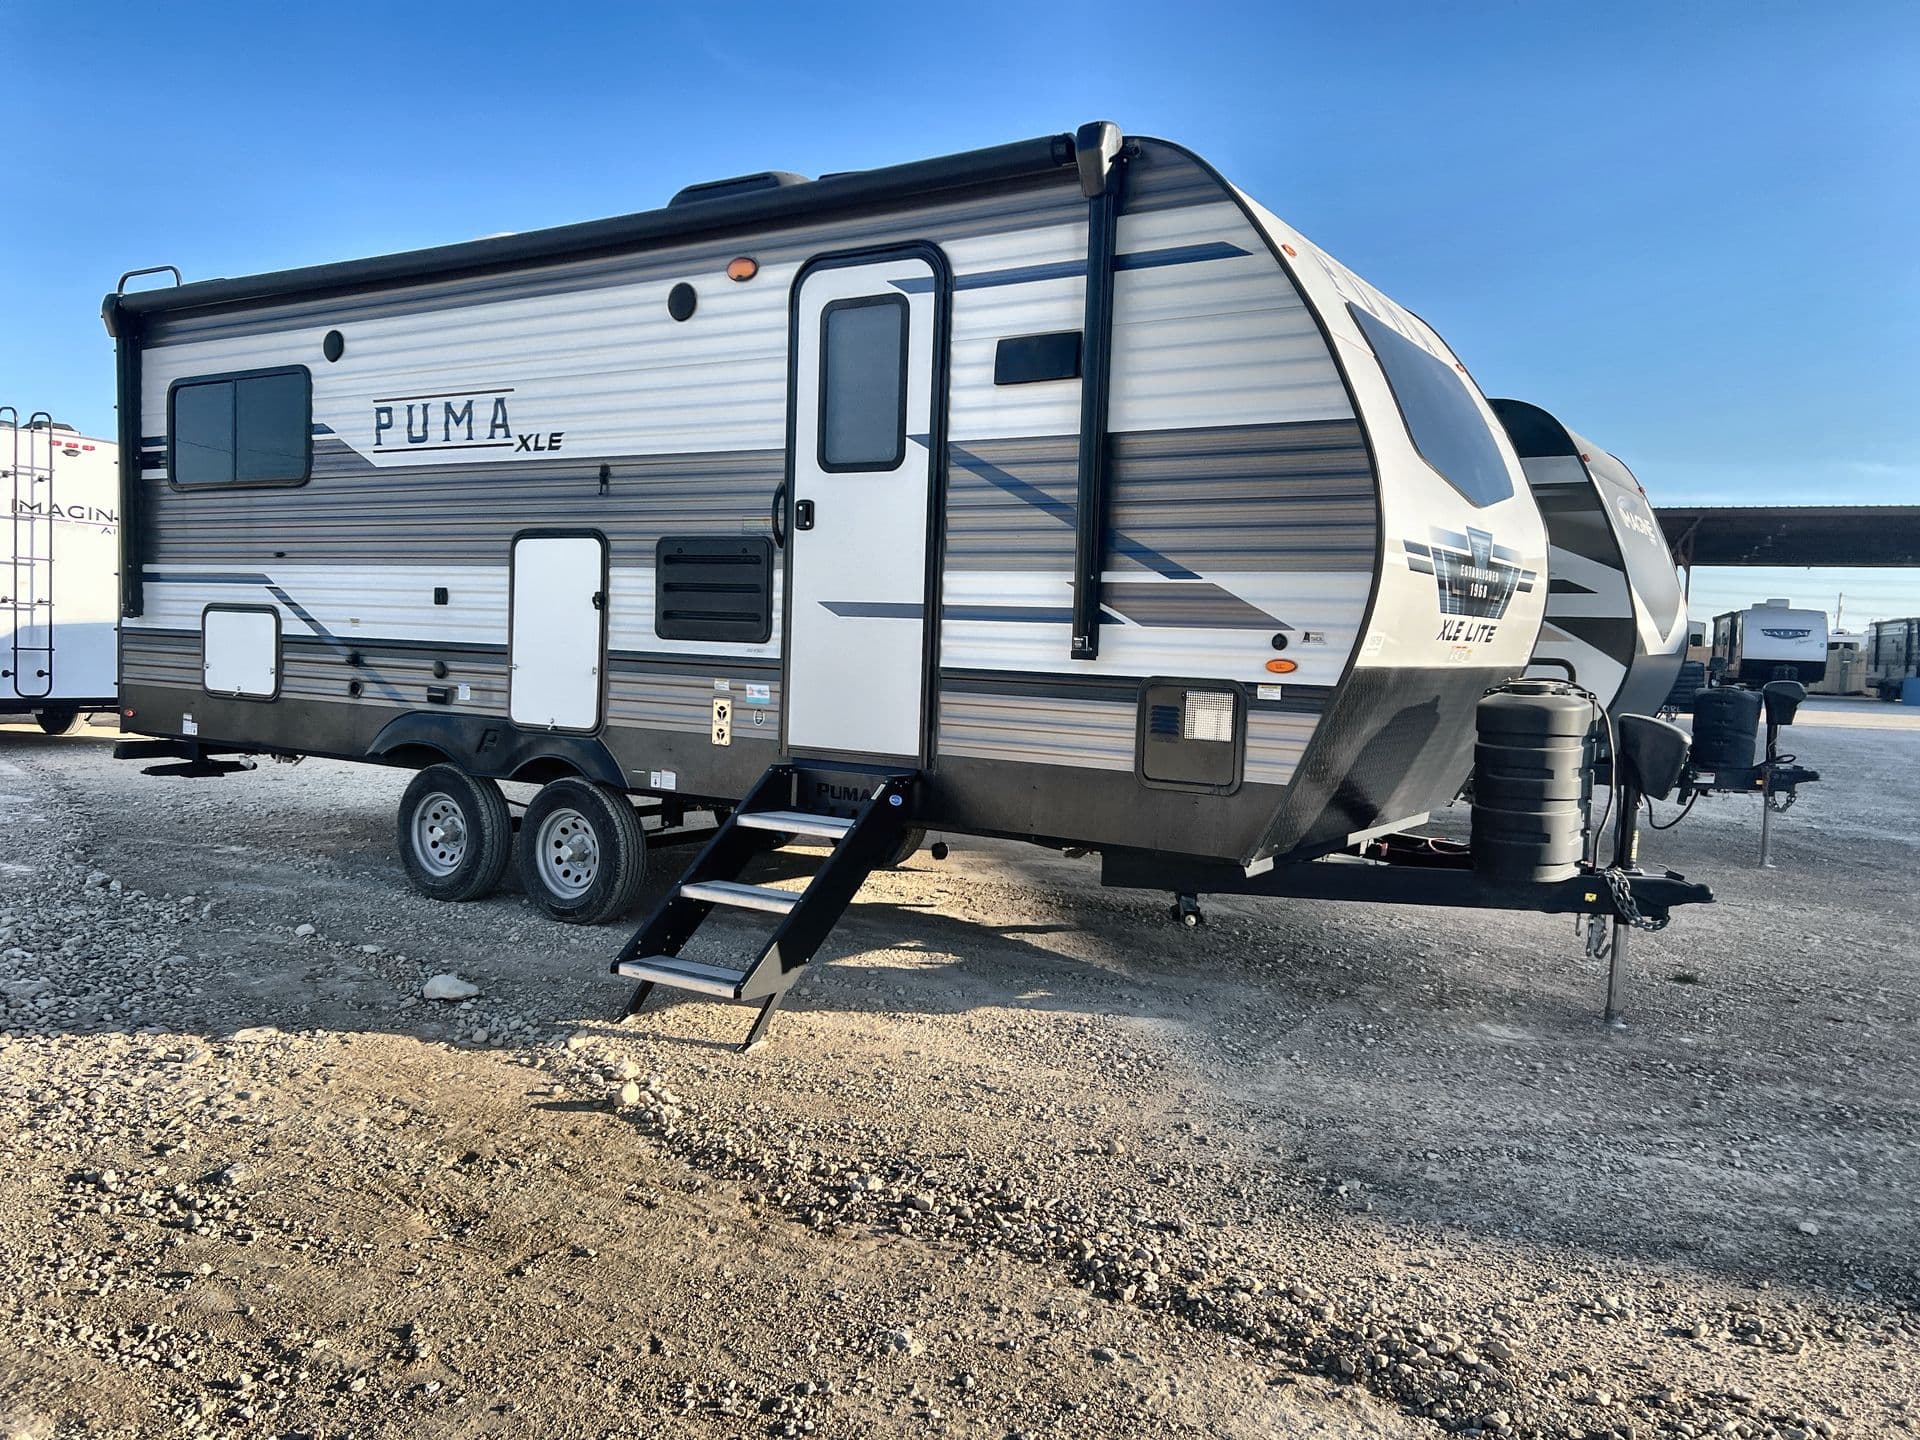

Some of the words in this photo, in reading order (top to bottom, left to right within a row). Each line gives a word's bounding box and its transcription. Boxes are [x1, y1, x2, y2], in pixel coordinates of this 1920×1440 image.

[374, 397, 512, 446] PUMA
[515, 431, 565, 452] XLE
[1460, 564, 1499, 583] ESTABLISHED
[1436, 619, 1465, 641] XLE
[1465, 623, 1498, 642] LITE
[816, 782, 871, 802] PUMA
